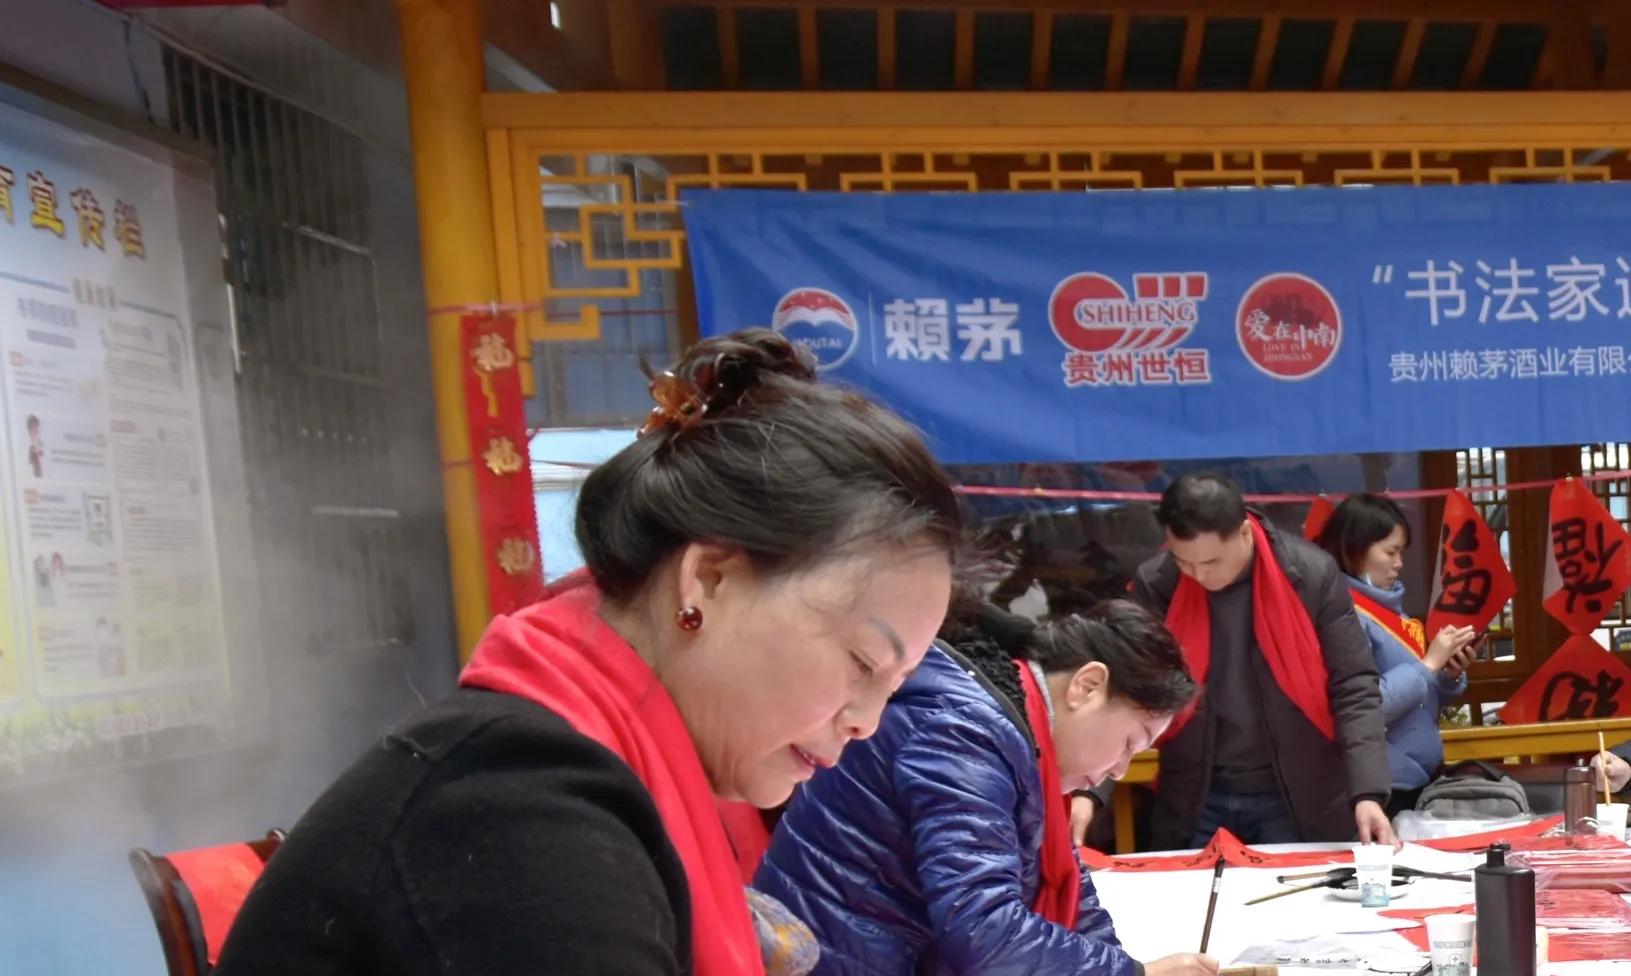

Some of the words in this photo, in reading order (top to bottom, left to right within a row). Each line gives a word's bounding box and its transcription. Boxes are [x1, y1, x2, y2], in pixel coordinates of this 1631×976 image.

[1082, 302, 1196, 323] SHIHENG
[1244, 308, 1336, 350] 爱在中南
[1062, 350, 1210, 387] 贵州世恒
